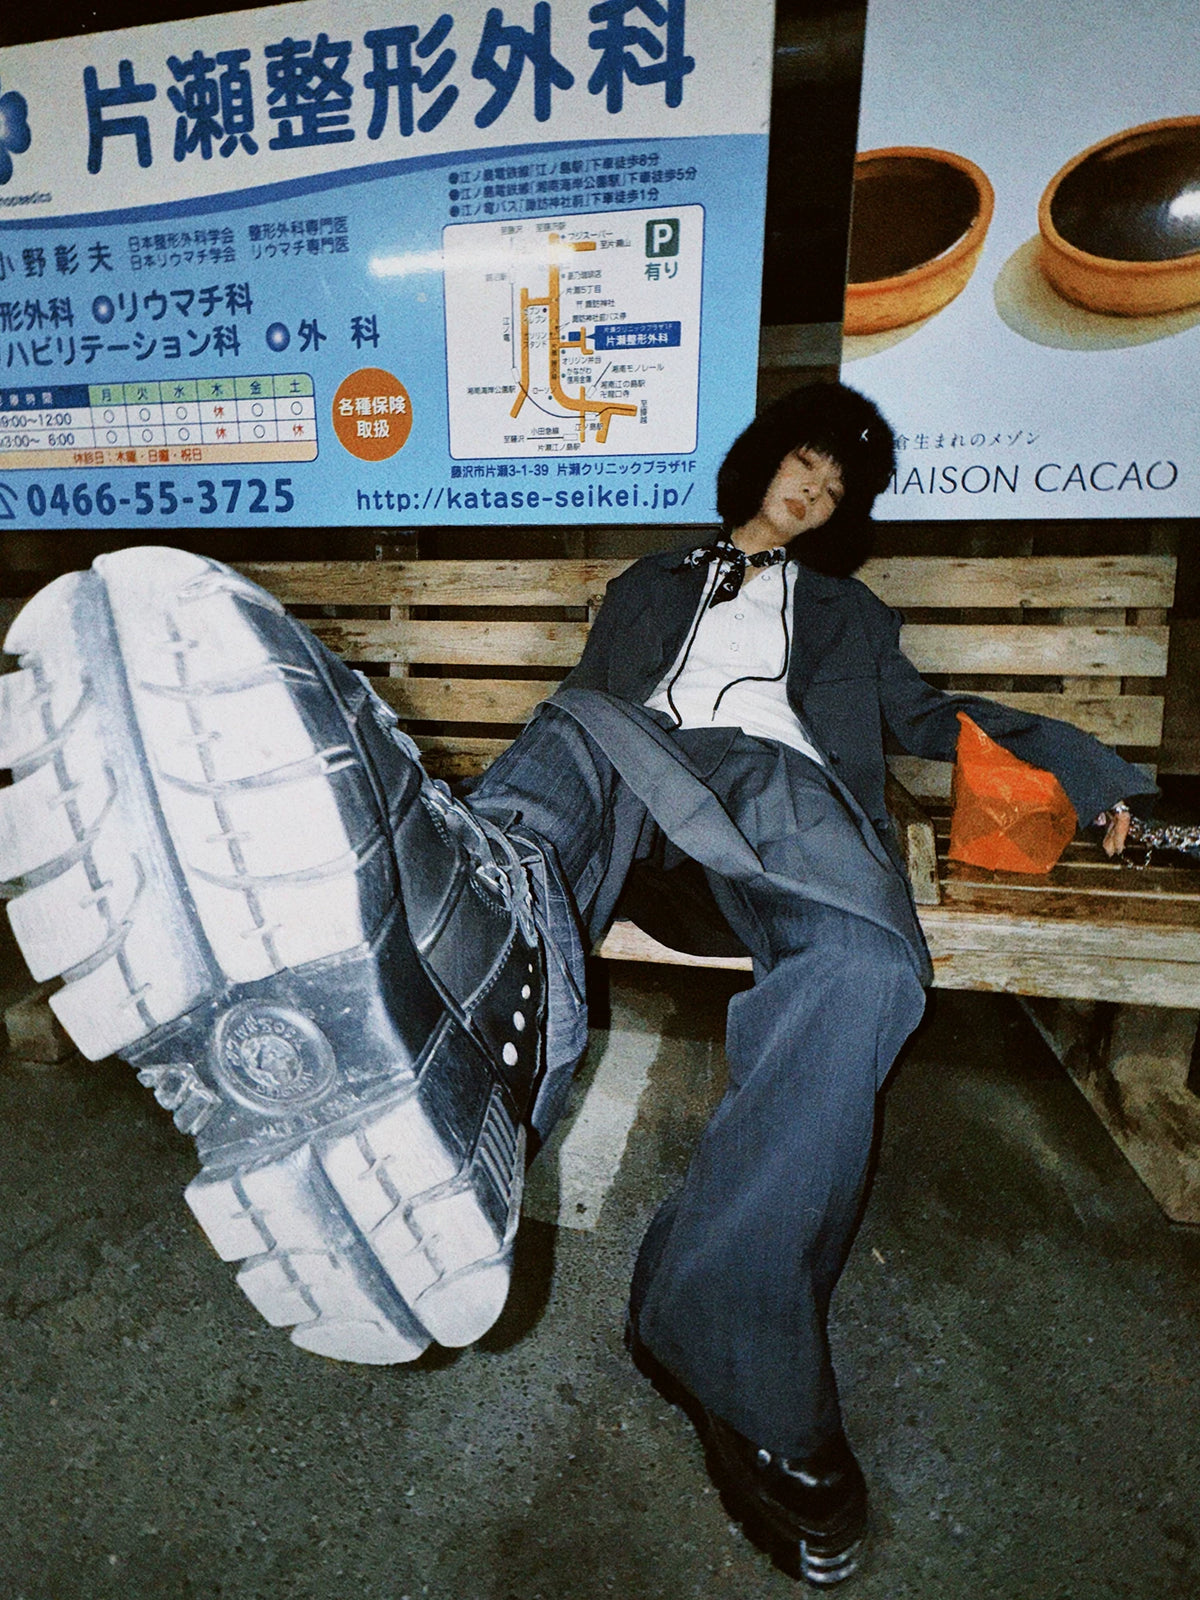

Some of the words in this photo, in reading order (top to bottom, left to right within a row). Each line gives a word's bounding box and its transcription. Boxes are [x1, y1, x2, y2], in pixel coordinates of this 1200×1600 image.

[83, 0, 695, 174] 片瀬整形外科
[128, 226, 235, 252] 日本整形外科学会
[248, 215, 349, 242] 整形外科専門医
[652, 222, 674, 254] P
[130, 245, 236, 271] 日本リウマチ学会
[252, 235, 350, 260] リウマチ専門医
[644, 262, 679, 281] 有り
[0, 296, 75, 333] 形外科
[119, 282, 253, 322] リウマチ科
[6, 324, 241, 368] ハビリテーション科
[606, 333, 669, 347] 片瀬整形外科
[101, 387, 111, 401] 月
[137, 386, 149, 401] 火
[173, 384, 185, 398] 水
[211, 383, 224, 396] 木
[250, 380, 262, 396] 金
[290, 379, 301, 394] 土
[213, 405, 224, 418] 休
[338, 396, 406, 416] 各種保険
[216, 427, 227, 440] 休
[292, 423, 304, 437] 休
[356, 420, 390, 438] 取扱
[451, 463, 549, 479] 藤沢市片瀬3-1-39
[557, 460, 697, 477] 片瀬クリニックプラザ1F
[1034, 460, 1179, 493] CACAO
[26, 478, 295, 517] 0466-55-3725
[357, 483, 695, 512] http://katase-seikei.jp/
